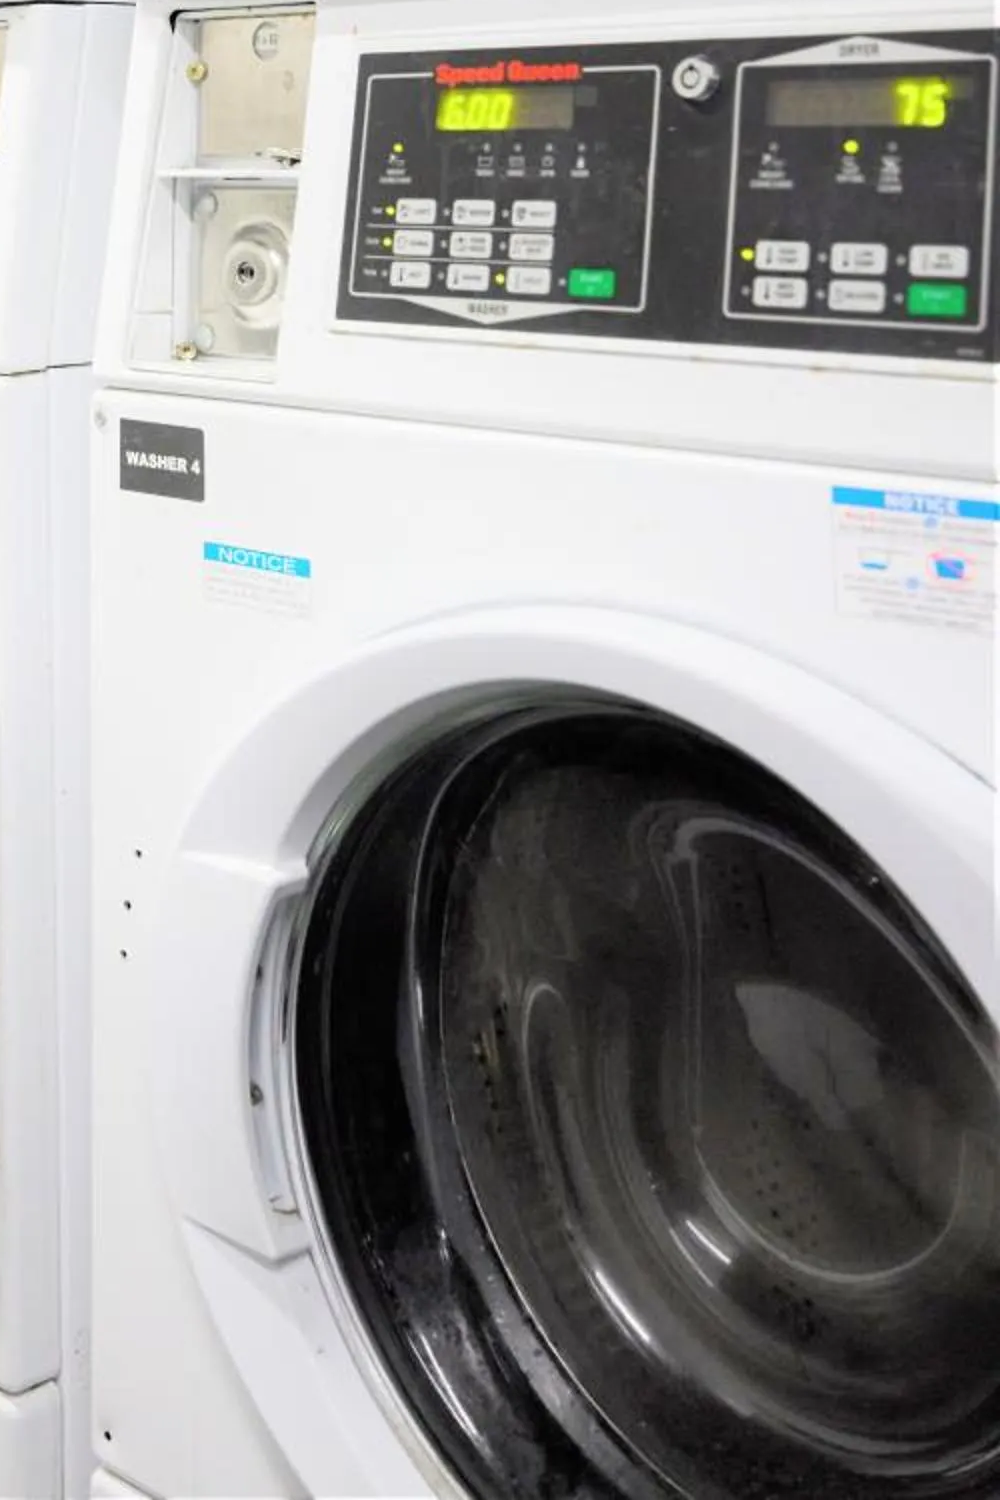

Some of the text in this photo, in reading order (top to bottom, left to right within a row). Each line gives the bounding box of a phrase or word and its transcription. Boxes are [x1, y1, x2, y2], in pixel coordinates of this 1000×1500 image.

[838, 43, 880, 57] DRYER
[435, 59, 582, 87] Speed Queen
[895, 80, 950, 127] 75
[125, 450, 201, 476] WASHER 4
[218, 546, 297, 576] NOTICE
